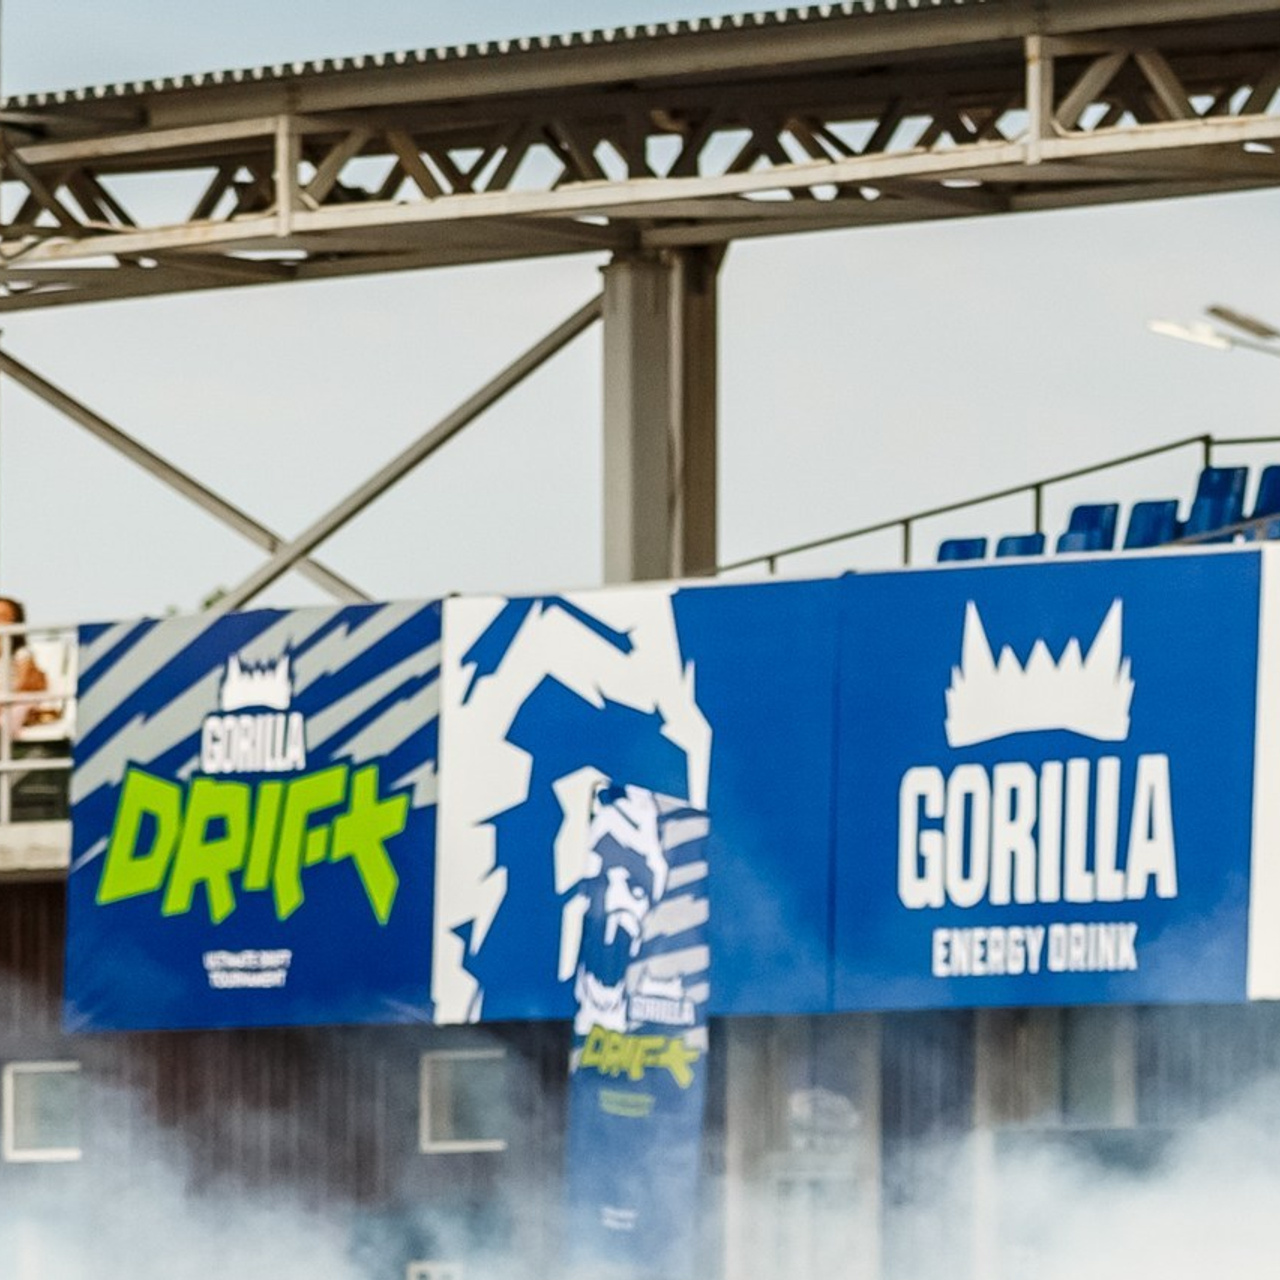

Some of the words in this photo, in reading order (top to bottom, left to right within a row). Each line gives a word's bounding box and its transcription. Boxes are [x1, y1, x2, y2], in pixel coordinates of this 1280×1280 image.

[202, 711, 306, 774] GORILLA
[96, 764, 410, 925] DRIFT
[897, 753, 1178, 909] GORILLA
[932, 925, 1044, 978] ENERGY
[1048, 922, 1139, 974] DRINK
[580, 1023, 699, 1089] DRIFT
